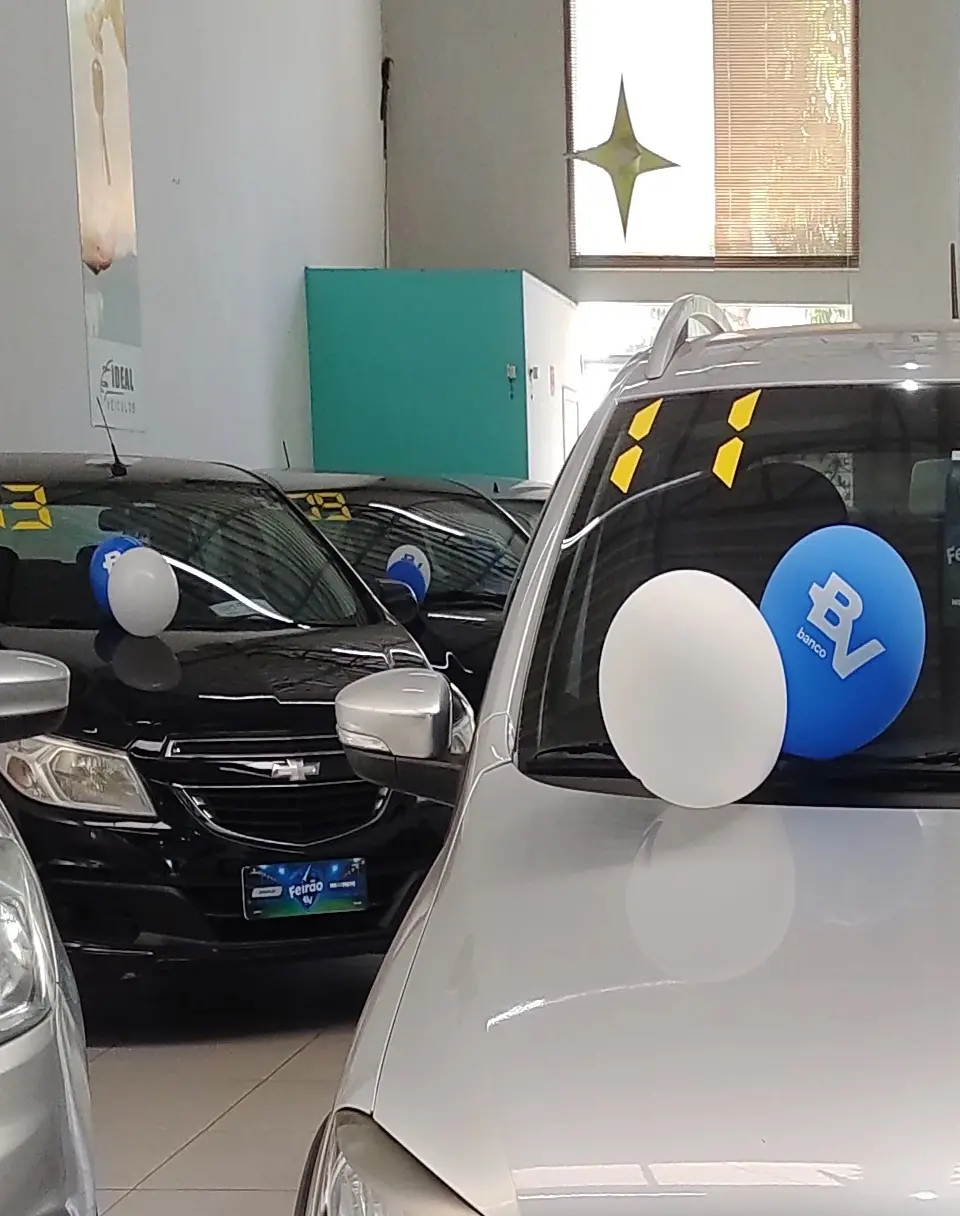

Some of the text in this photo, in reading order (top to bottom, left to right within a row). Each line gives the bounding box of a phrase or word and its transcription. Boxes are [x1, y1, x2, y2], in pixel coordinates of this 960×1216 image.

[111, 364, 134, 391] IDEAL
[0, 484, 52, 530] 3
[807, 571, 887, 680] BV
[796, 627, 827, 659] banco
[288, 879, 324, 899] Feirão
